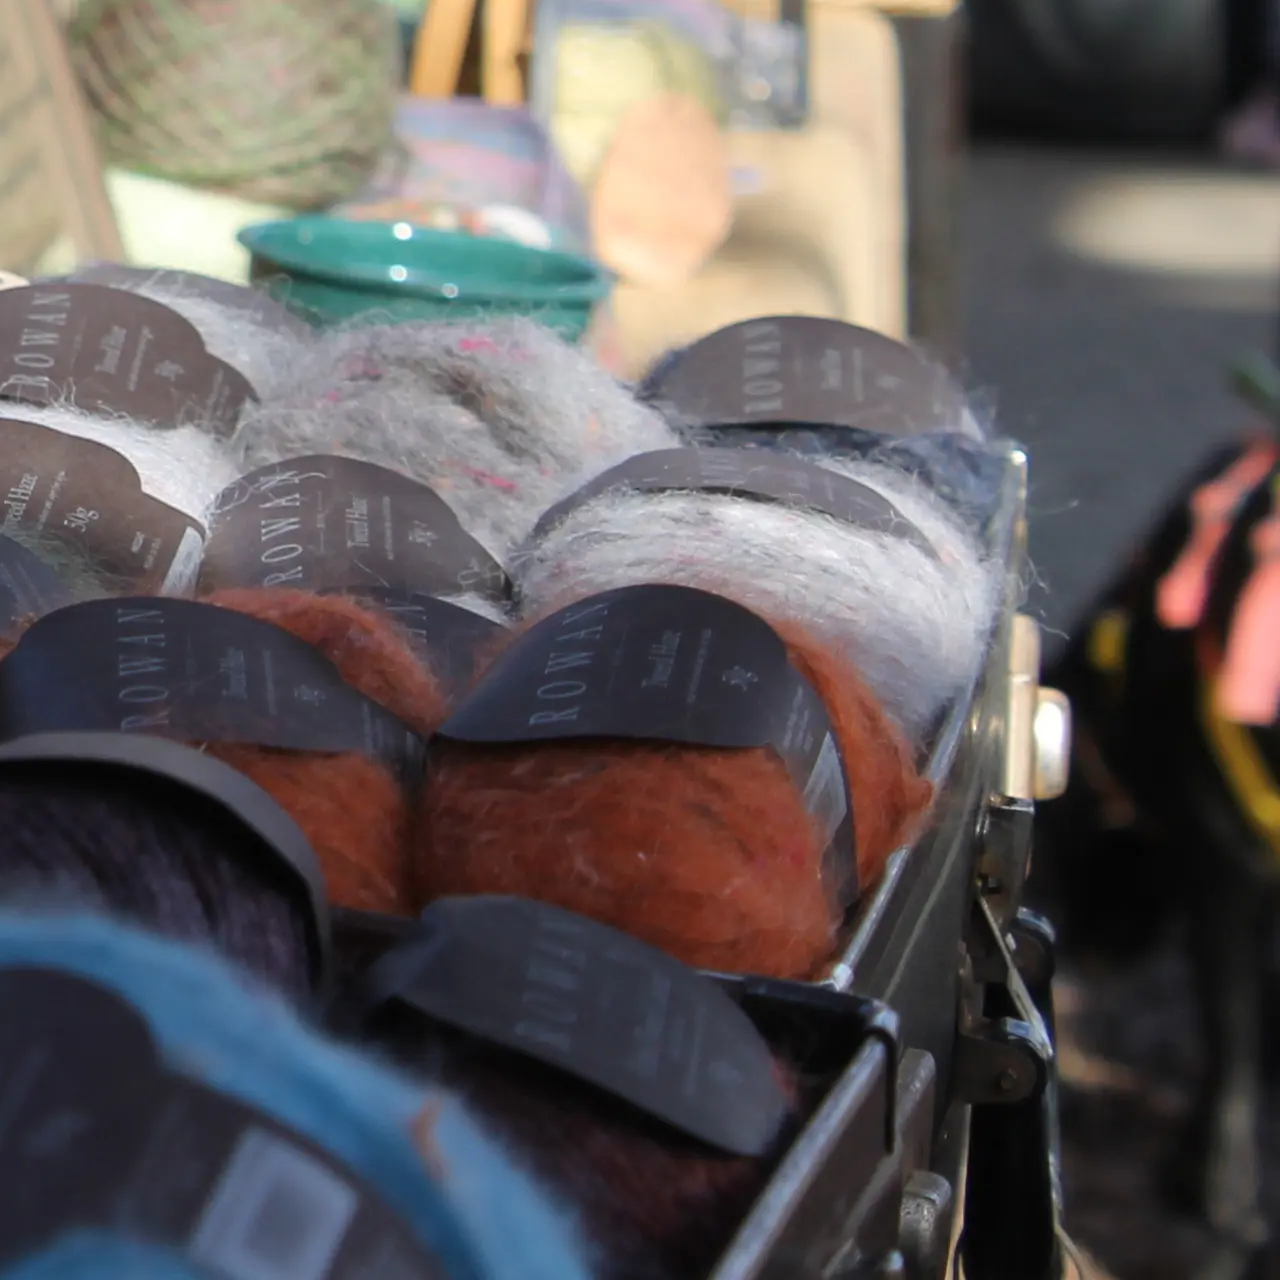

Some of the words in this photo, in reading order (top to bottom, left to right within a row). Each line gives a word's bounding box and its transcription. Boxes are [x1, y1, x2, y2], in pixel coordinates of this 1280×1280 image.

[11, 293, 71, 388] ROWAN
[63, 507, 100, 533] 50g
[259, 470, 303, 587] ROWAN
[116, 607, 171, 732] ROWAN
[529, 603, 609, 725] ROWAN
